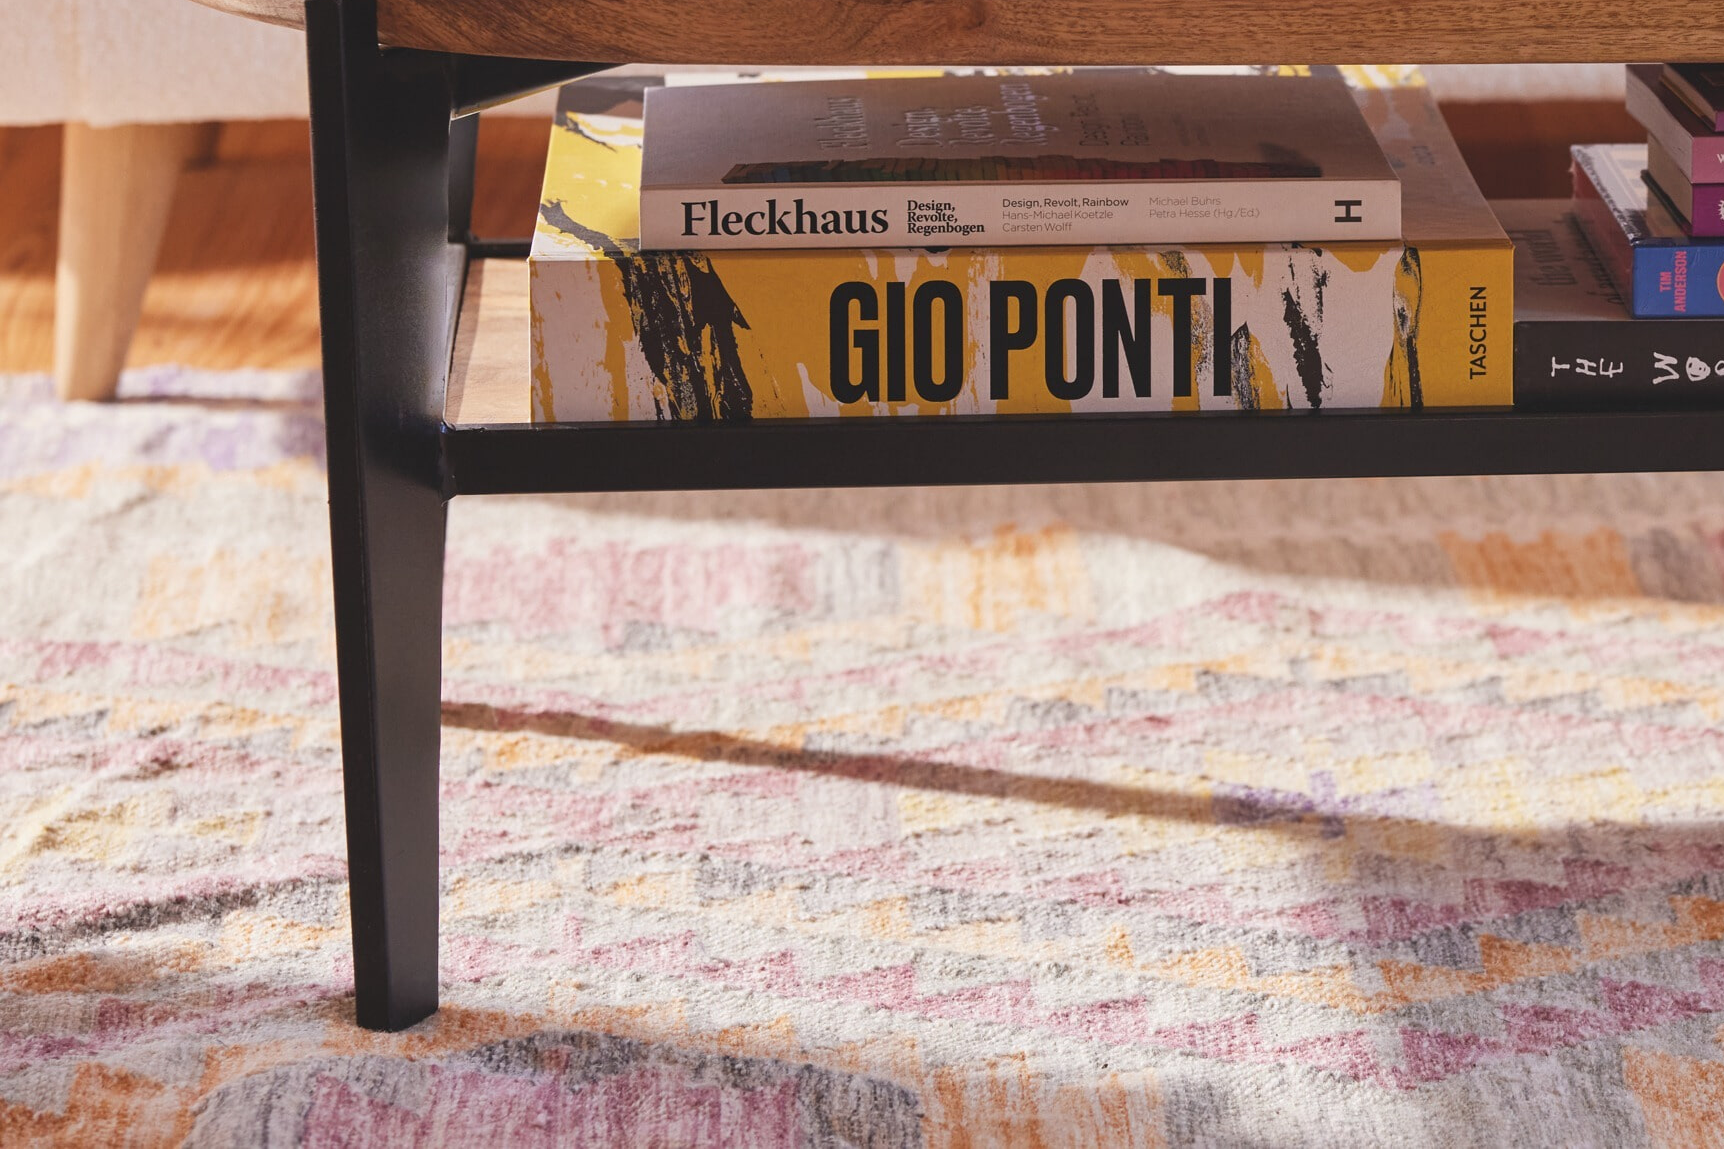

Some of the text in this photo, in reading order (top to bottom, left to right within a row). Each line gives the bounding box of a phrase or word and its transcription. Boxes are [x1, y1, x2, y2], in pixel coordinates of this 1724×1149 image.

[907, 200, 956, 214] Design,
[1002, 197, 1129, 209] Design, Revolt, Rainbow
[1149, 196, 1221, 206] Michael Buhrs
[681, 198, 889, 237] Fleckhaus
[907, 211, 958, 224] Revolte,
[1002, 209, 1113, 220] Hans-Michael Koetzle
[1149, 208, 1177, 219] Petra
[1179, 208, 1211, 218] Hesse
[907, 222, 985, 237] Regenbogen
[1002, 221, 1072, 232] Carsten Wolff
[1659, 271, 1672, 293] TIM
[1674, 251, 1687, 313] ANDERSON
[1469, 286, 1487, 380] TASCHEN
[829, 277, 1232, 404] GIO PONTI
[1551, 356, 1624, 379] THE
